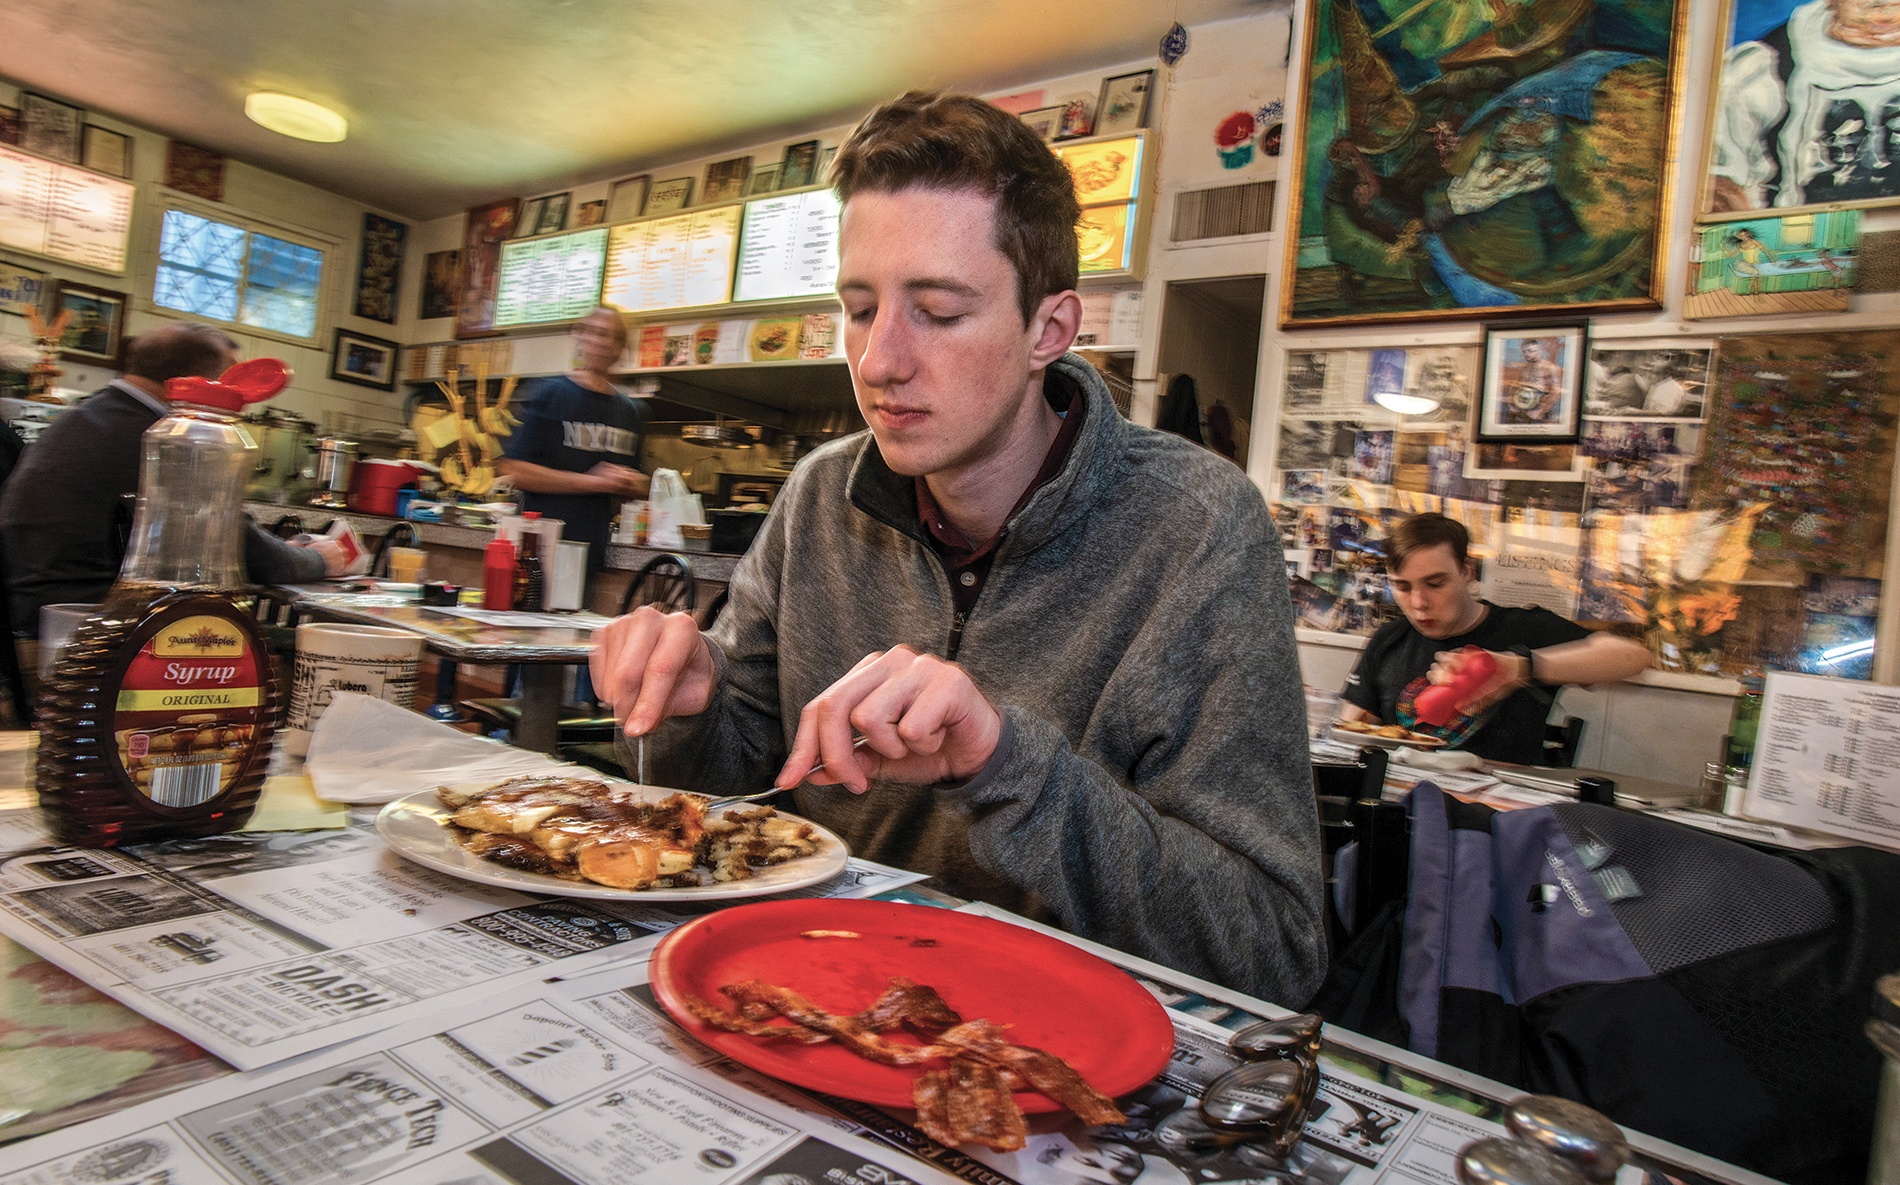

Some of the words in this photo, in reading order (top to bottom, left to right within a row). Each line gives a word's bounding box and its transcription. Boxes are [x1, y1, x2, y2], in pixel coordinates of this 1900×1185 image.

[168, 636, 197, 648] Aunt
[199, 636, 236, 647] Maple's
[164, 662, 236, 685] Syrup
[162, 694, 231, 706] ORIGINAL
[508, 909, 604, 949] CONTRACTORS
[265, 981, 331, 1011] BICYCLE
[271, 964, 388, 1012] DASH
[575, 1028, 606, 1050] Barber
[600, 1052, 614, 1072] Shop
[325, 1070, 419, 1105] FENCE
[404, 1099, 445, 1151] TECH
